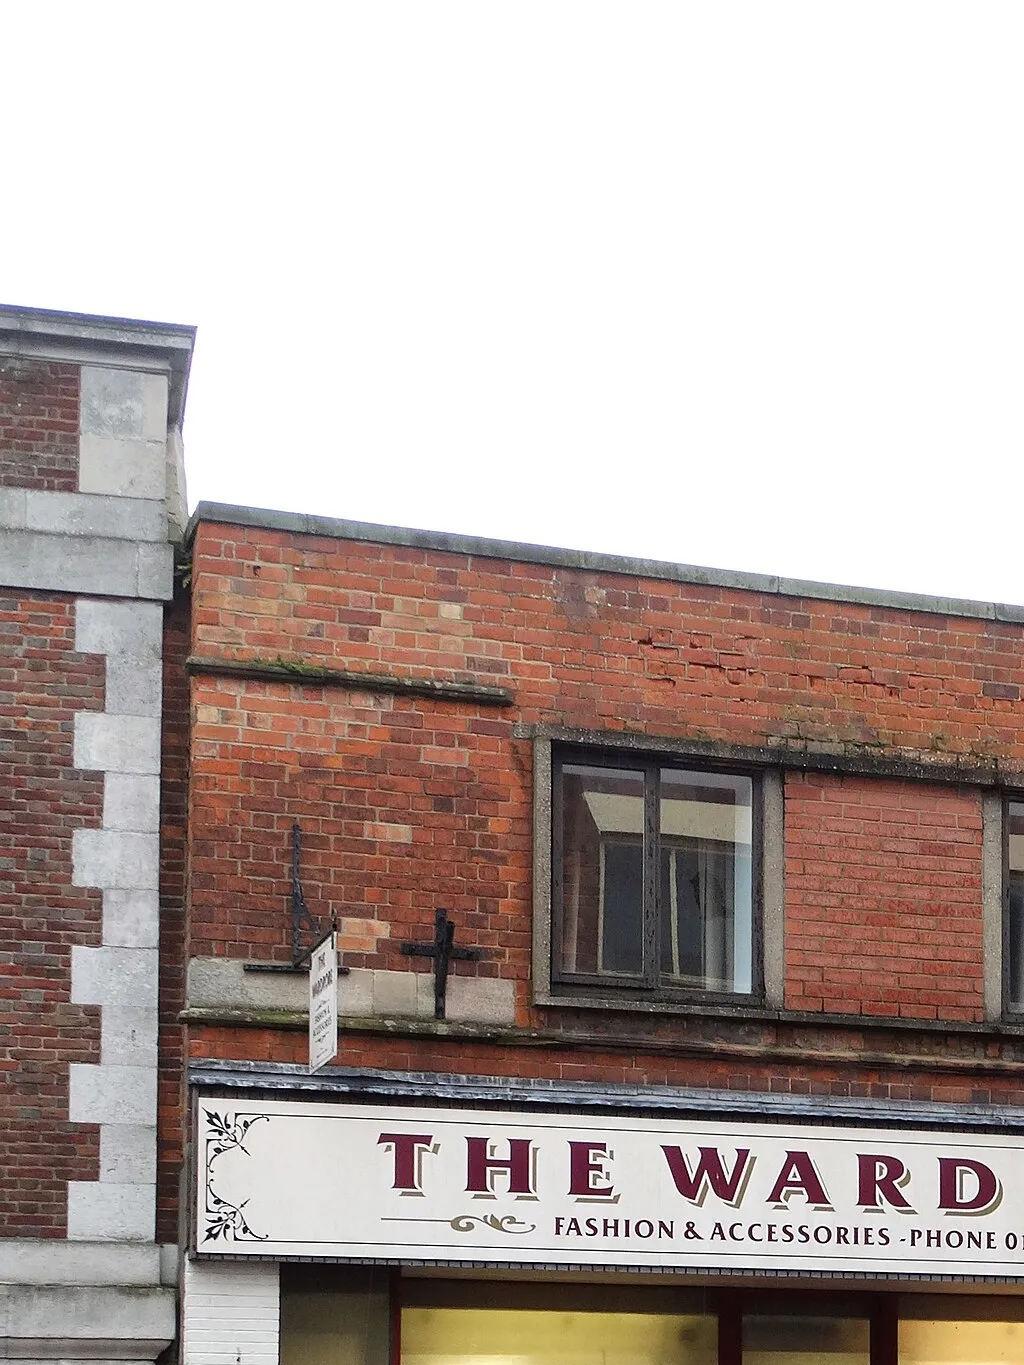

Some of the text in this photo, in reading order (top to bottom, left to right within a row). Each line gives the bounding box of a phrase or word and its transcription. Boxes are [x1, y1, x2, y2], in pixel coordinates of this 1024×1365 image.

[376, 1132, 621, 1205] THE
[555, 1216, 675, 1240] FASHION
[683, 1223, 703, 1240] &
[710, 1222, 891, 1248] ACCESSORIES
